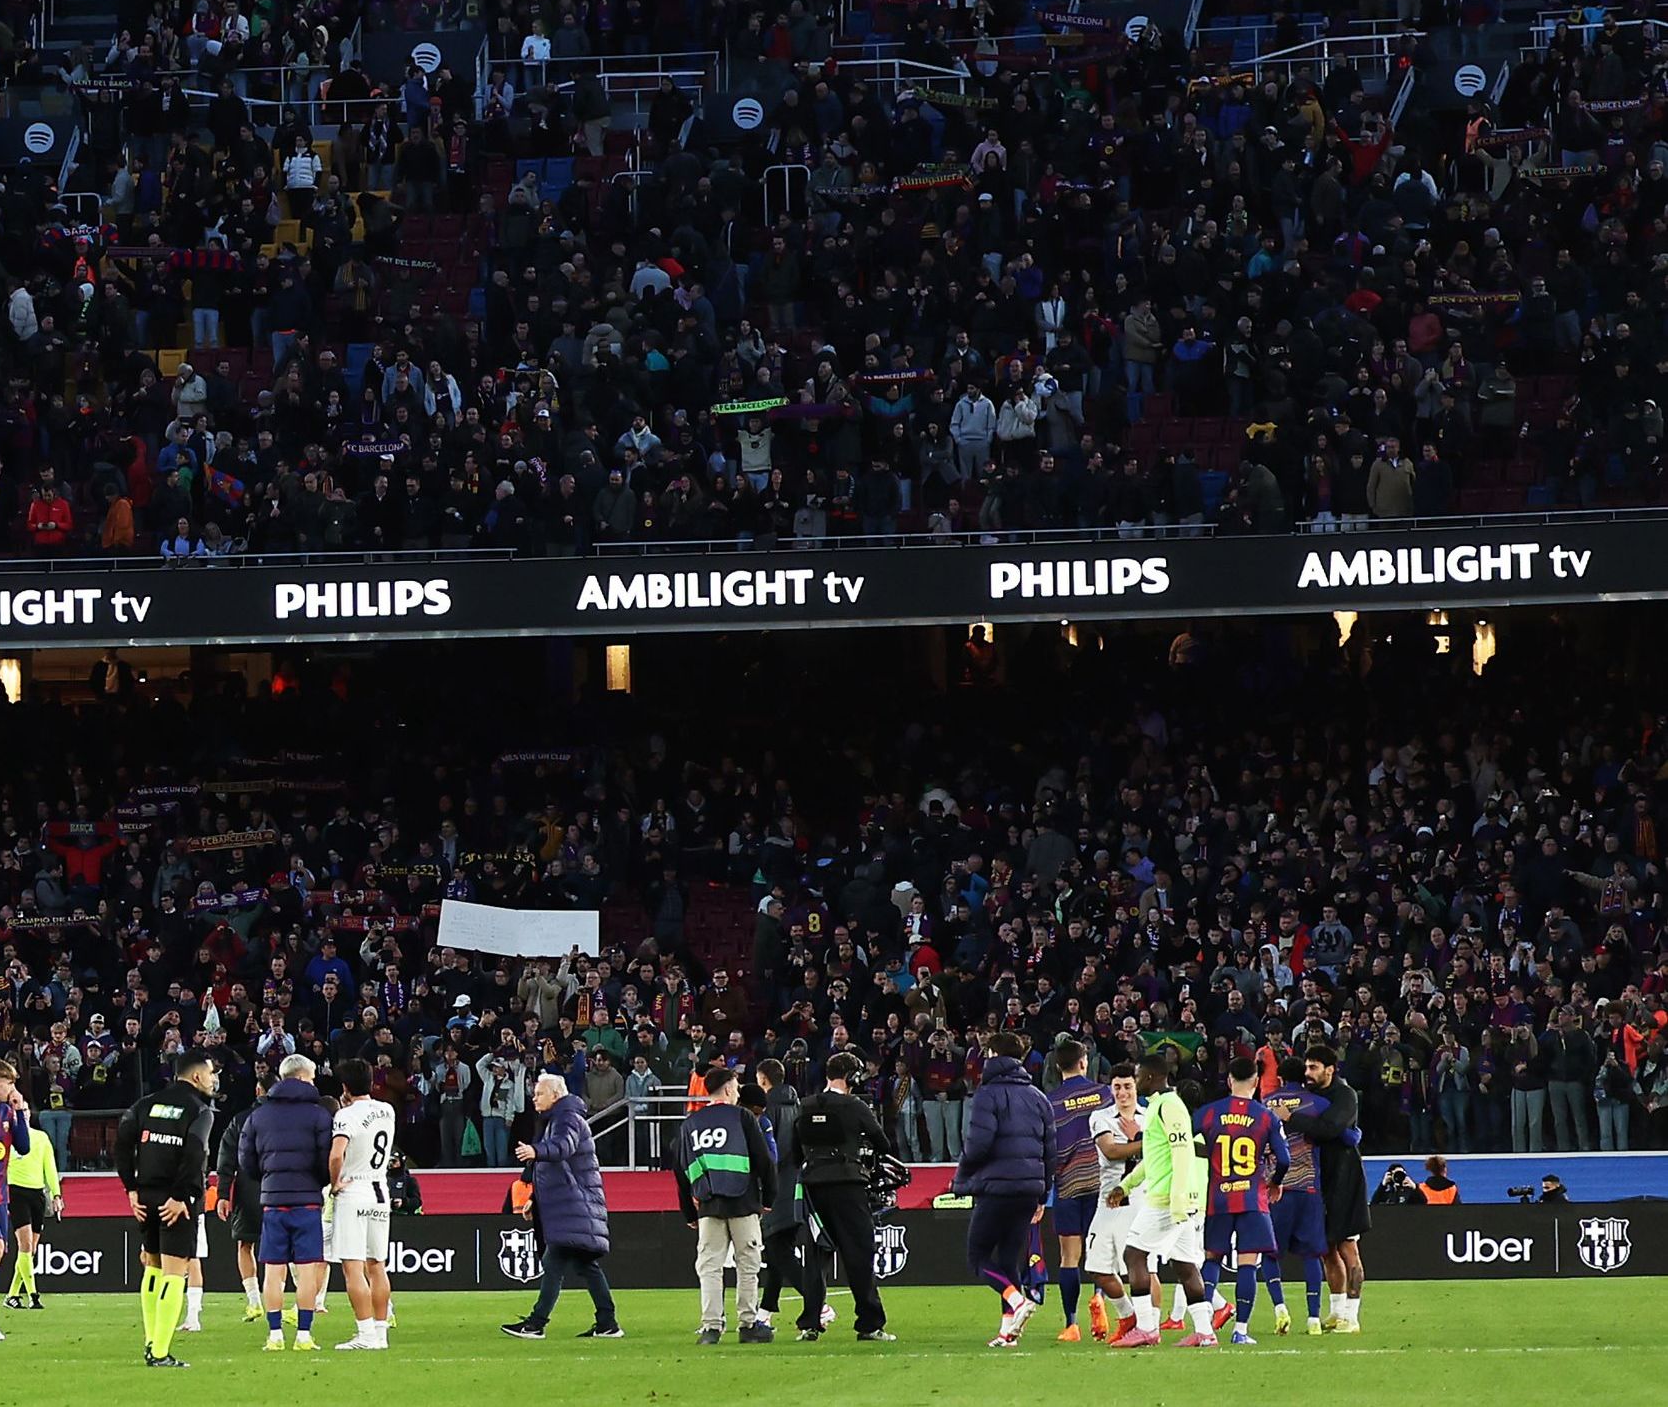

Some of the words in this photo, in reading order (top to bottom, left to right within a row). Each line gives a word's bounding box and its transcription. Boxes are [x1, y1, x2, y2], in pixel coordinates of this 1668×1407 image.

[1056, 15, 1103, 25] BARCELONA
[991, 558, 1169, 598] PHILIPS
[1298, 544, 1538, 587] AMBILIGHT
[1549, 545, 1591, 577] tv
[276, 580, 451, 618] PHILIPS
[577, 570, 813, 610] AMBILIGHT
[823, 572, 864, 603] tv
[111, 591, 151, 622] tv
[808, 913, 821, 933] 8
[1220, 1114, 1255, 1128] ROONY
[370, 1130, 387, 1170] 8
[691, 1128, 727, 1152] 169
[1168, 1133, 1187, 1142] OK
[1215, 1135, 1257, 1178] 19
[1447, 1231, 1533, 1262] Uber
